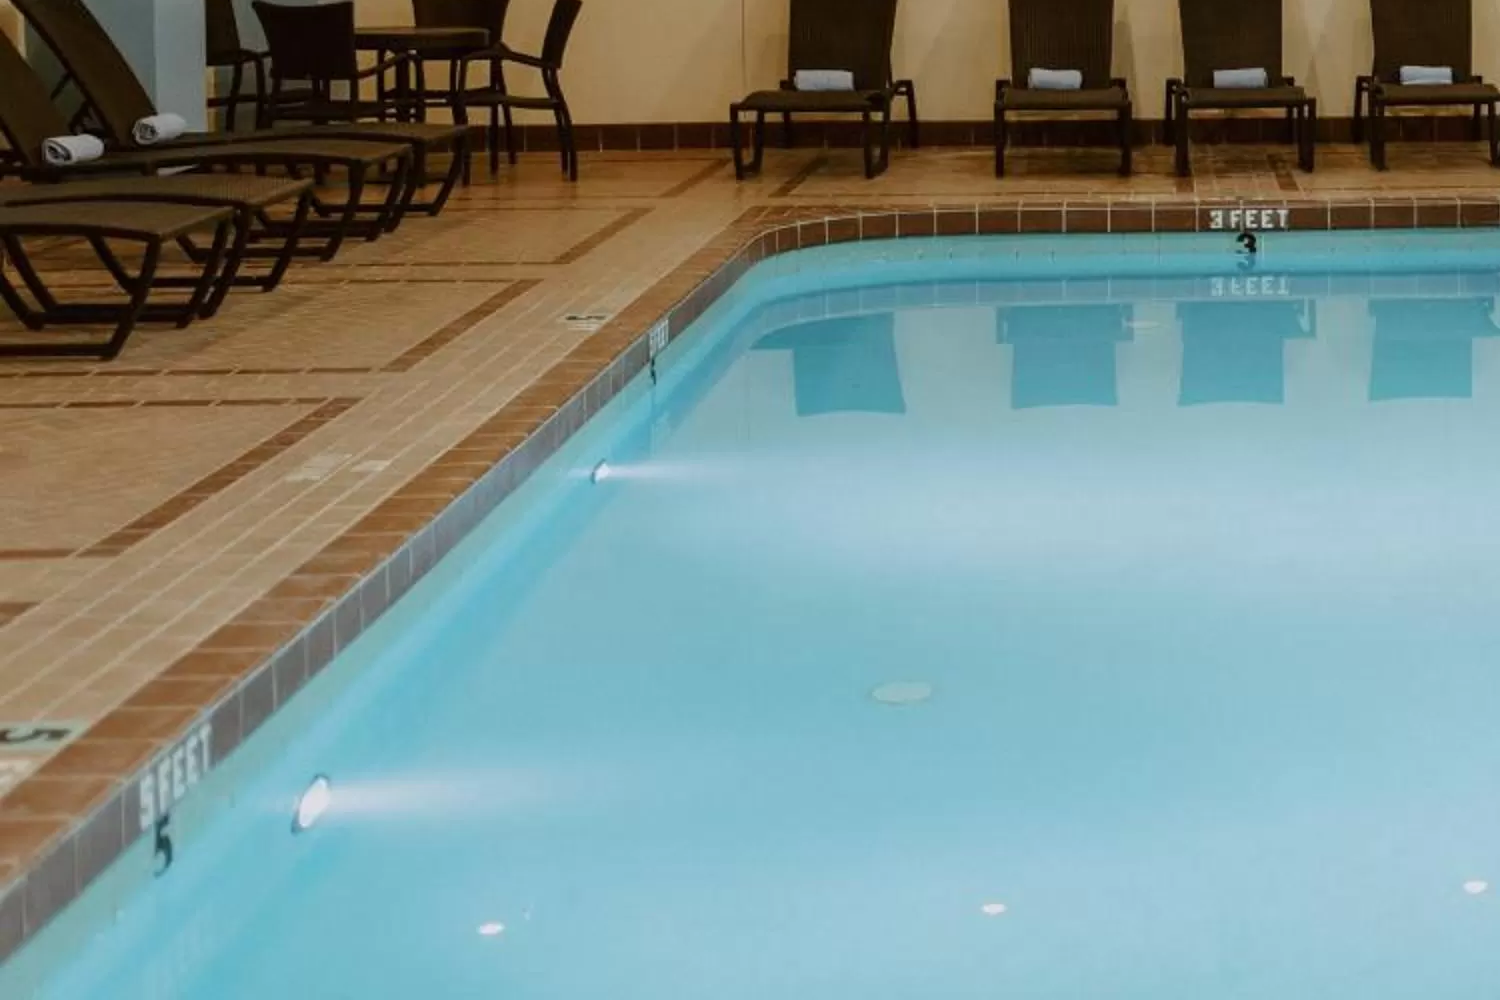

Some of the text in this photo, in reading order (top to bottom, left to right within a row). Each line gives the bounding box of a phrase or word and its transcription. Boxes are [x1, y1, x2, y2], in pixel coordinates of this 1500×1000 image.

[1209, 209, 1289, 229] 3 FEET
[1236, 233, 1257, 253] 3
[139, 722, 212, 832] 5 FEET
[153, 813, 173, 878] 5
